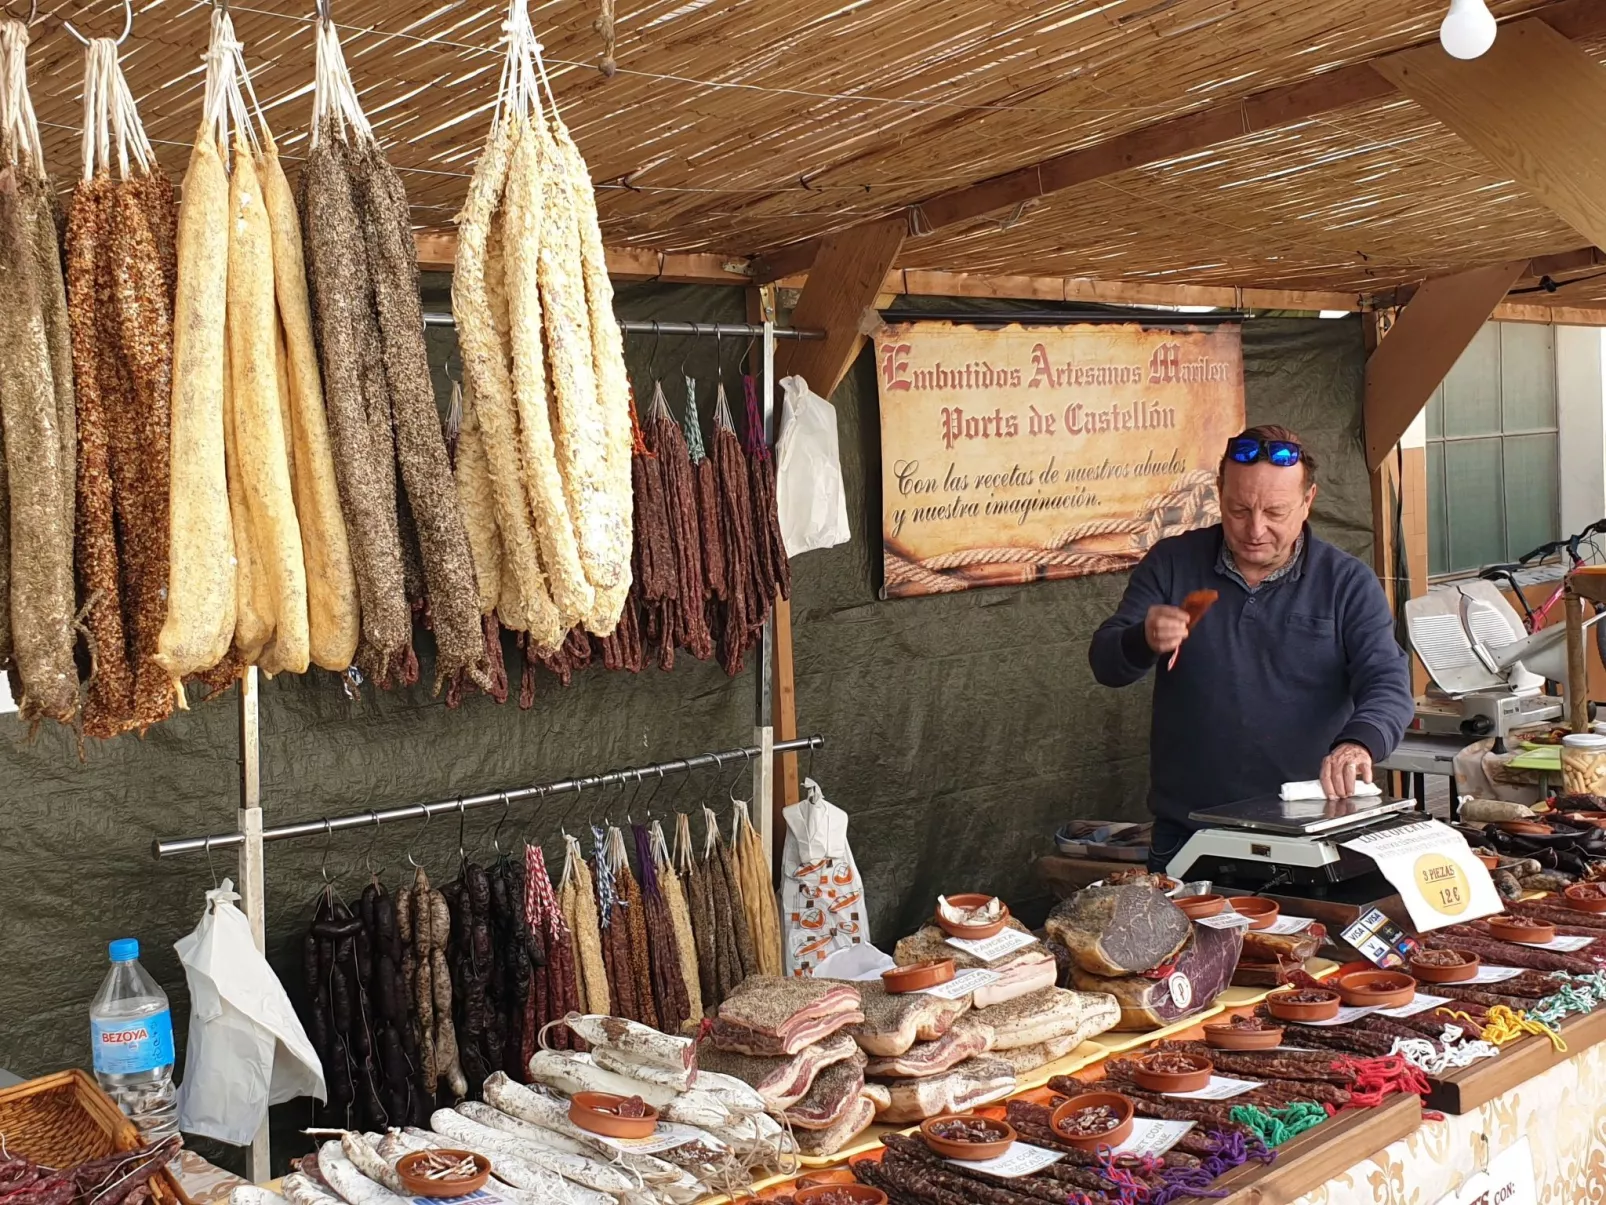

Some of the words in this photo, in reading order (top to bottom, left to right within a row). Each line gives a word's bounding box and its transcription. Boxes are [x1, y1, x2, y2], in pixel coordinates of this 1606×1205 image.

[880, 343, 1022, 392] Embutidos
[1028, 343, 1142, 389] Artesanos
[1148, 342, 1230, 385] Marilen
[940, 406, 1019, 450] Ports
[1028, 404, 1056, 436] de
[1064, 401, 1176, 436] Castellón
[893, 459, 939, 498] Con
[943, 462, 969, 492] las
[974, 464, 1034, 490] recetas
[1039, 455, 1059, 485] de
[1065, 458, 1129, 483] nuestros
[1133, 448, 1186, 478] abuelos
[892, 508, 906, 538] y
[912, 496, 980, 523] nuestra
[985, 486, 1101, 526] imaginación.
[1423, 870, 1429, 881] 3
[1429, 865, 1455, 880] PIEZAS
[1365, 912, 1381, 925] VISA
[1348, 927, 1365, 941] VISA
[102, 1029, 147, 1043] BEZOYA
[1145, 1121, 1165, 1139] CON
[1494, 1182, 1515, 1205] CON:
